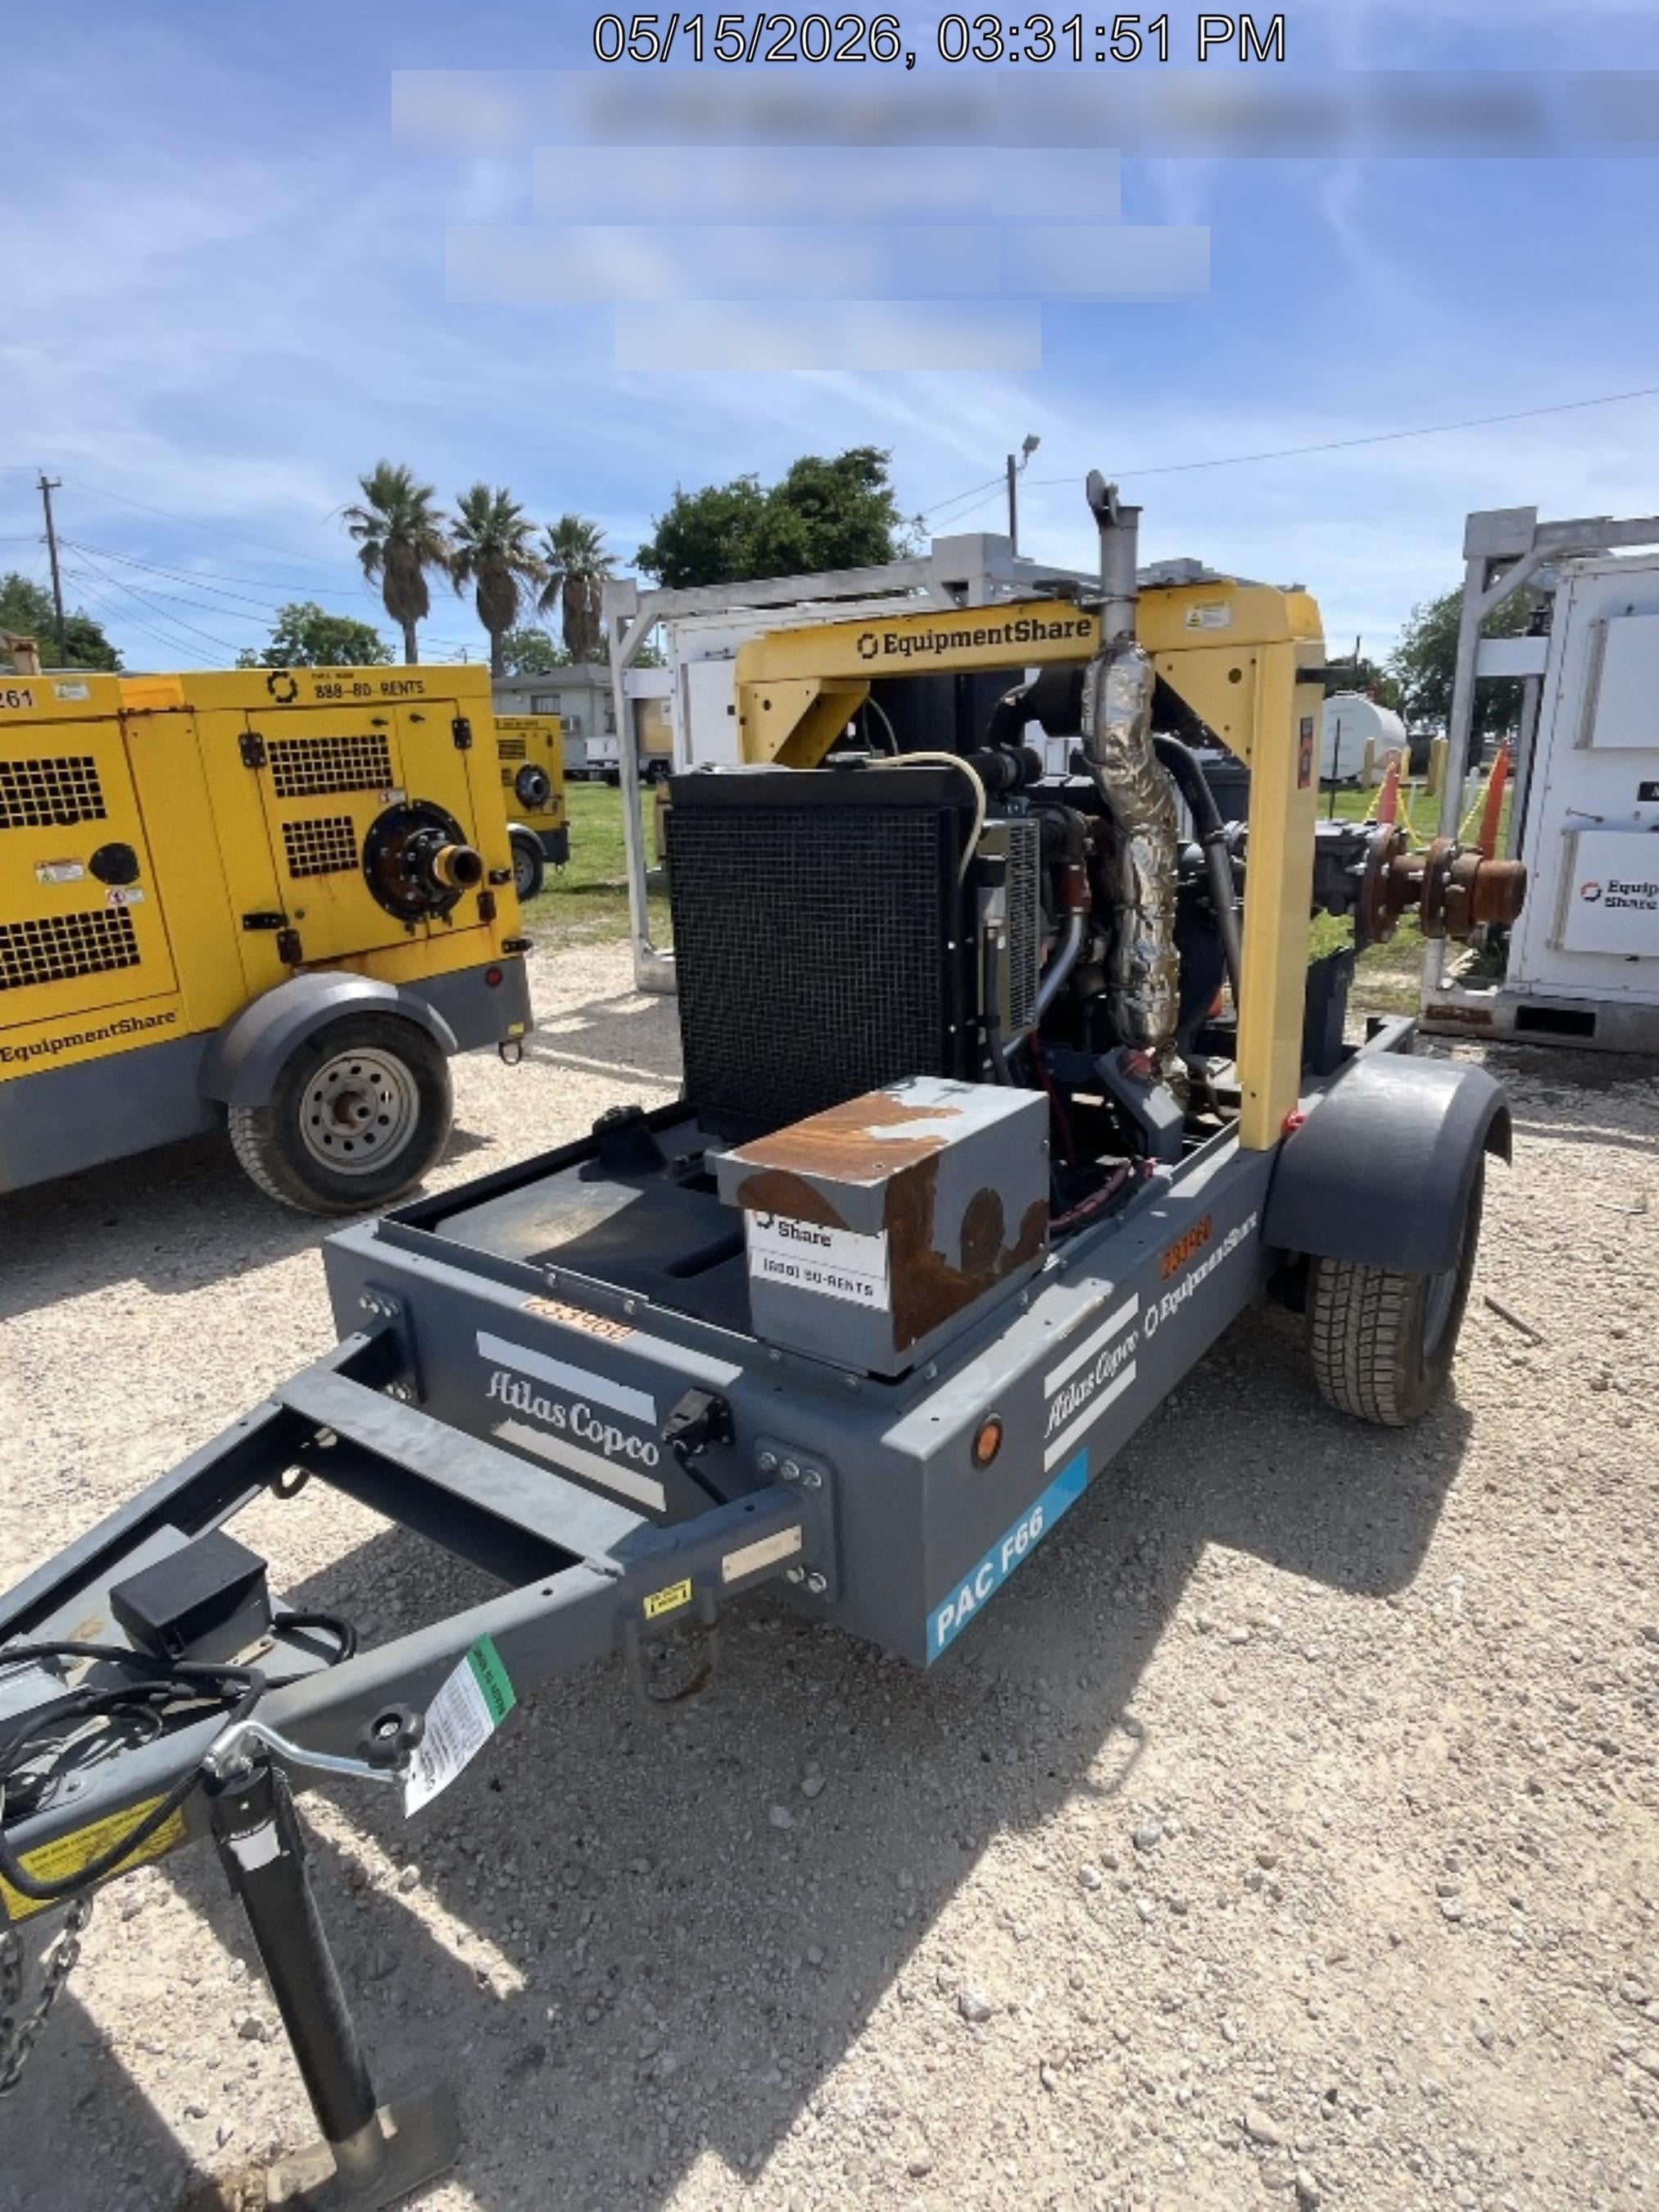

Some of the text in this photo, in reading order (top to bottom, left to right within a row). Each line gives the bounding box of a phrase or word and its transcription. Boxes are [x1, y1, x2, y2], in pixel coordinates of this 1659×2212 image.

[884, 619, 1092, 656] EquipmentShare
[1604, 896, 1658, 910] Share
[0, 1012, 176, 1063] EquipmentShare
[778, 1220, 832, 1247] Share
[1159, 1211, 1258, 1322] EquipmentShare
[486, 1370, 660, 1466] Atlas Copco
[1043, 1330, 1139, 1439] Atlas Copco
[937, 1505, 1043, 1648] PAC F66
